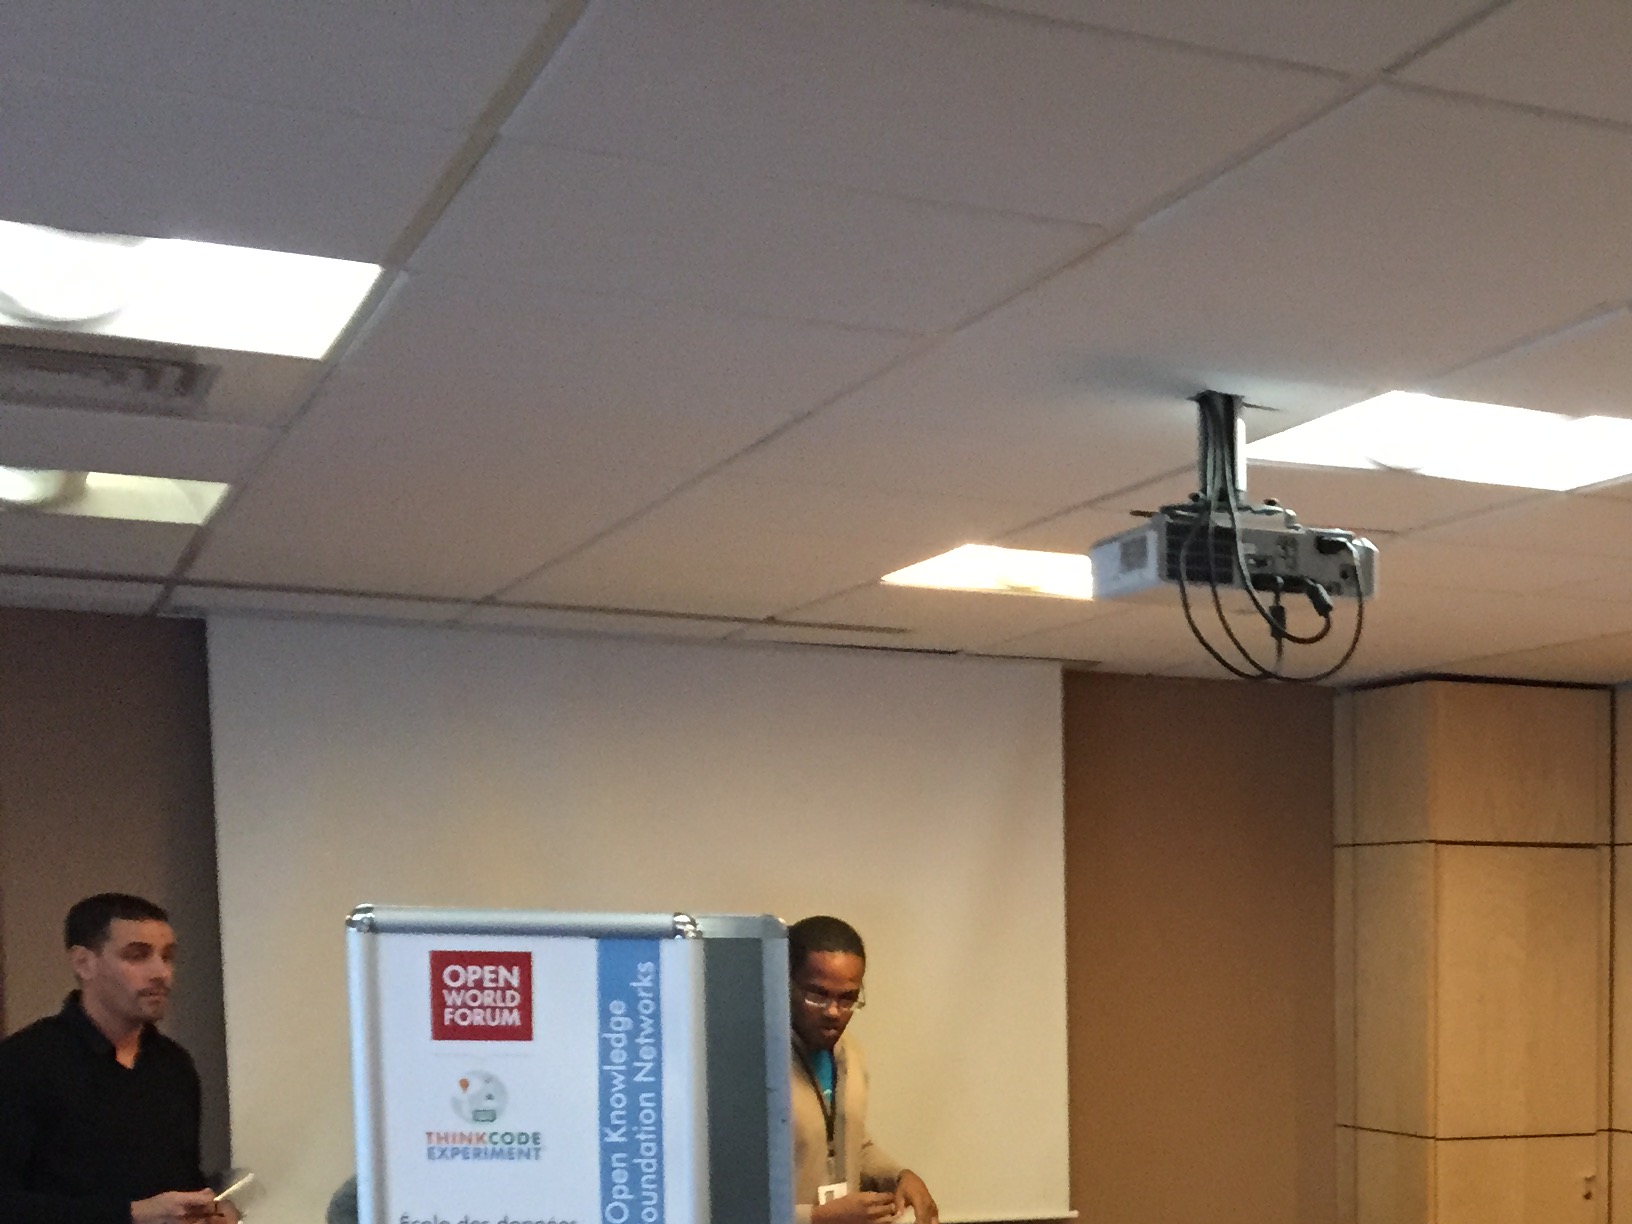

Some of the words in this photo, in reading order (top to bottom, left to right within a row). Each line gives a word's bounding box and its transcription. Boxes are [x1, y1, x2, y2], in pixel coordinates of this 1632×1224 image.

[442, 964, 520, 988] OPEN
[442, 989, 521, 1007] WORLD
[443, 1007, 521, 1027] FORUM
[629, 961, 657, 1082] Networks
[602, 1000, 634, 1142] Knowledge
[426, 1146, 541, 1161] EXPERIMENT
[604, 1152, 634, 1224] Open
